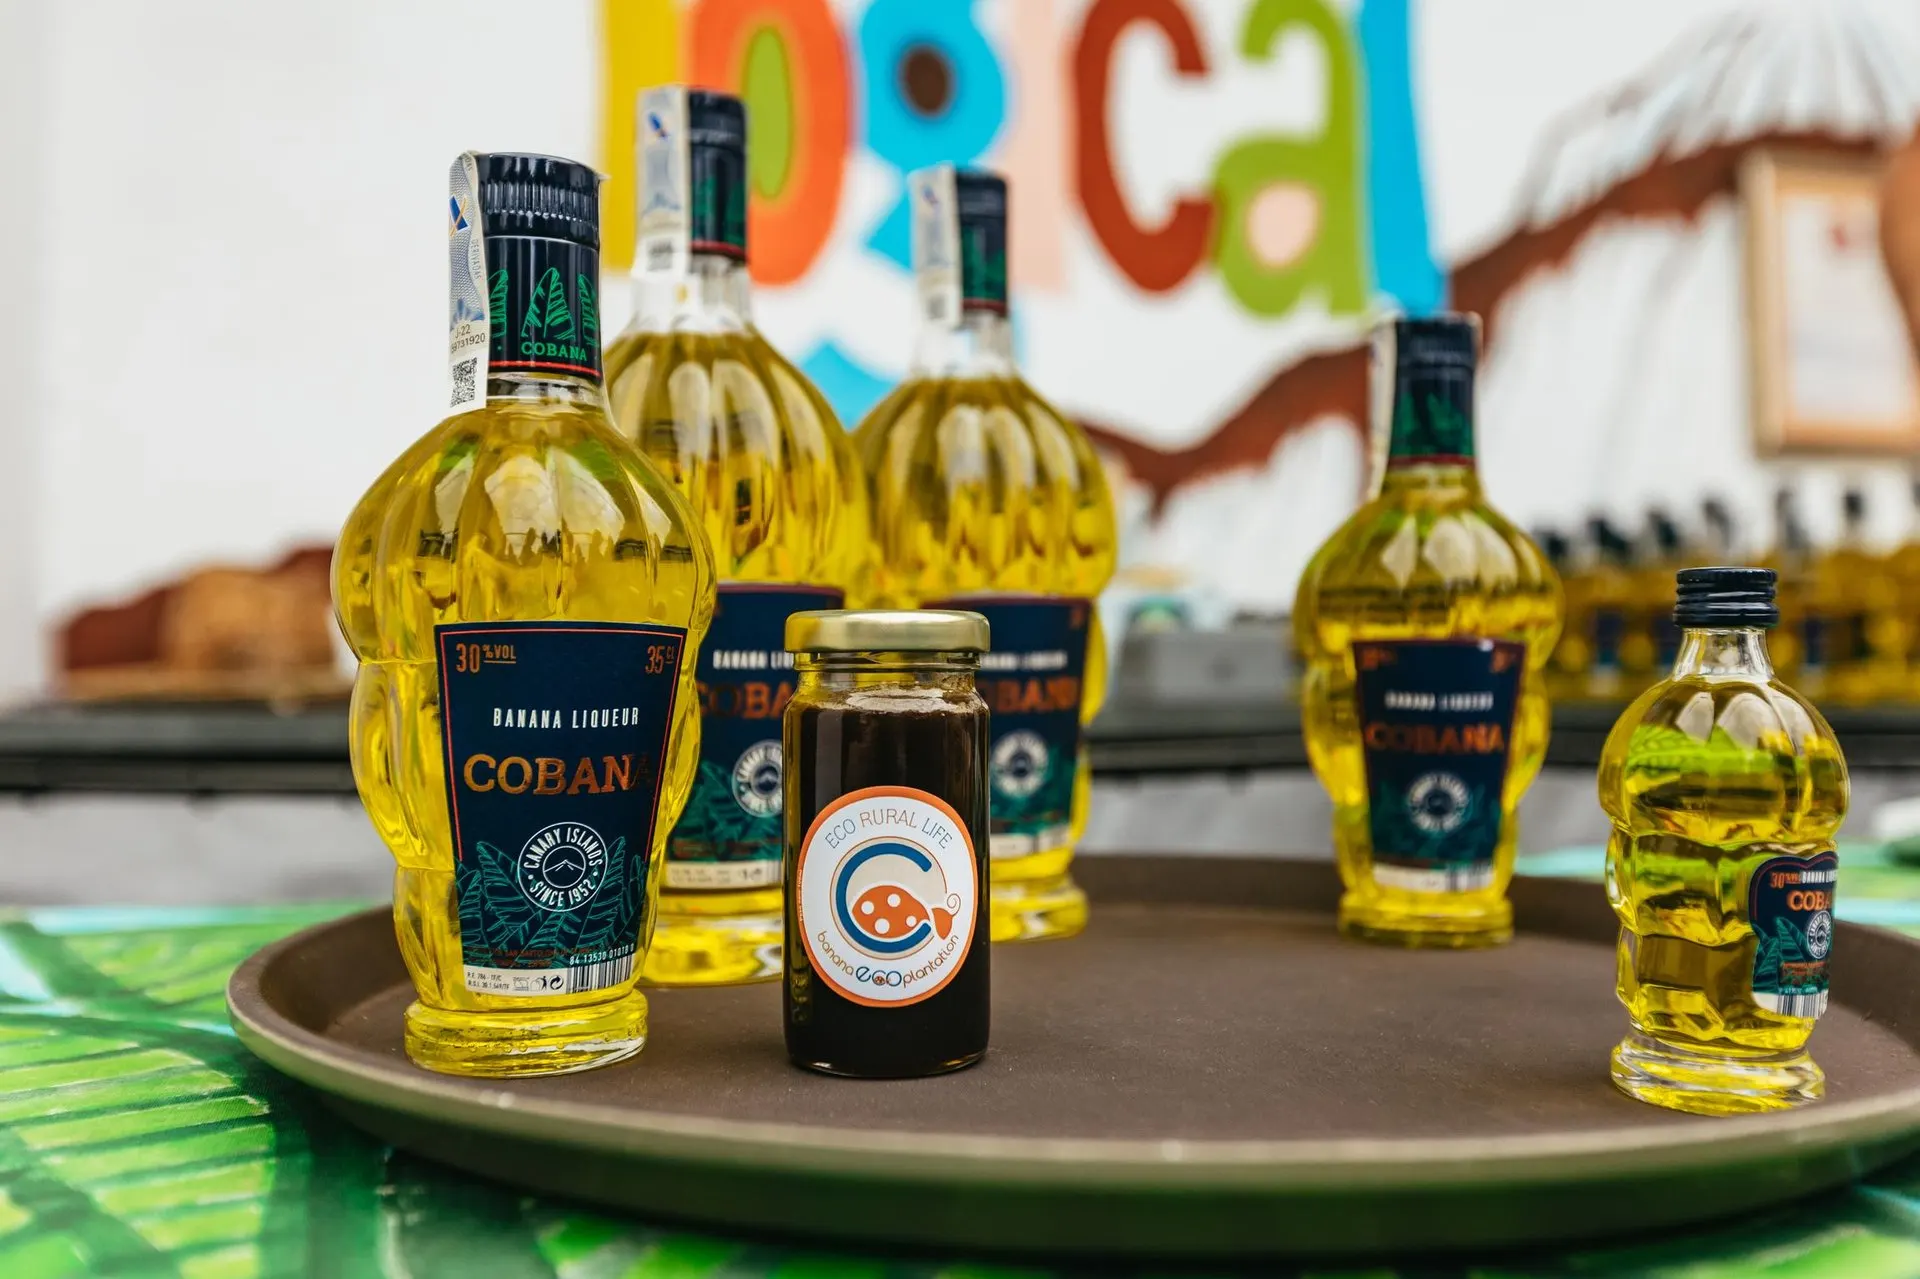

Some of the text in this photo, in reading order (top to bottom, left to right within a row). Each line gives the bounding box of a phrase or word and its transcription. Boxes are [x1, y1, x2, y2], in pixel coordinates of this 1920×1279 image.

[521, 341, 587, 361] COBANA
[493, 706, 640, 729] BANANA LIQUEUR
[824, 808, 953, 849] ECO RURAL LIFE
[523, 827, 603, 869] CANARY ISLANDS
[529, 879, 596, 907] SINCE 1952
